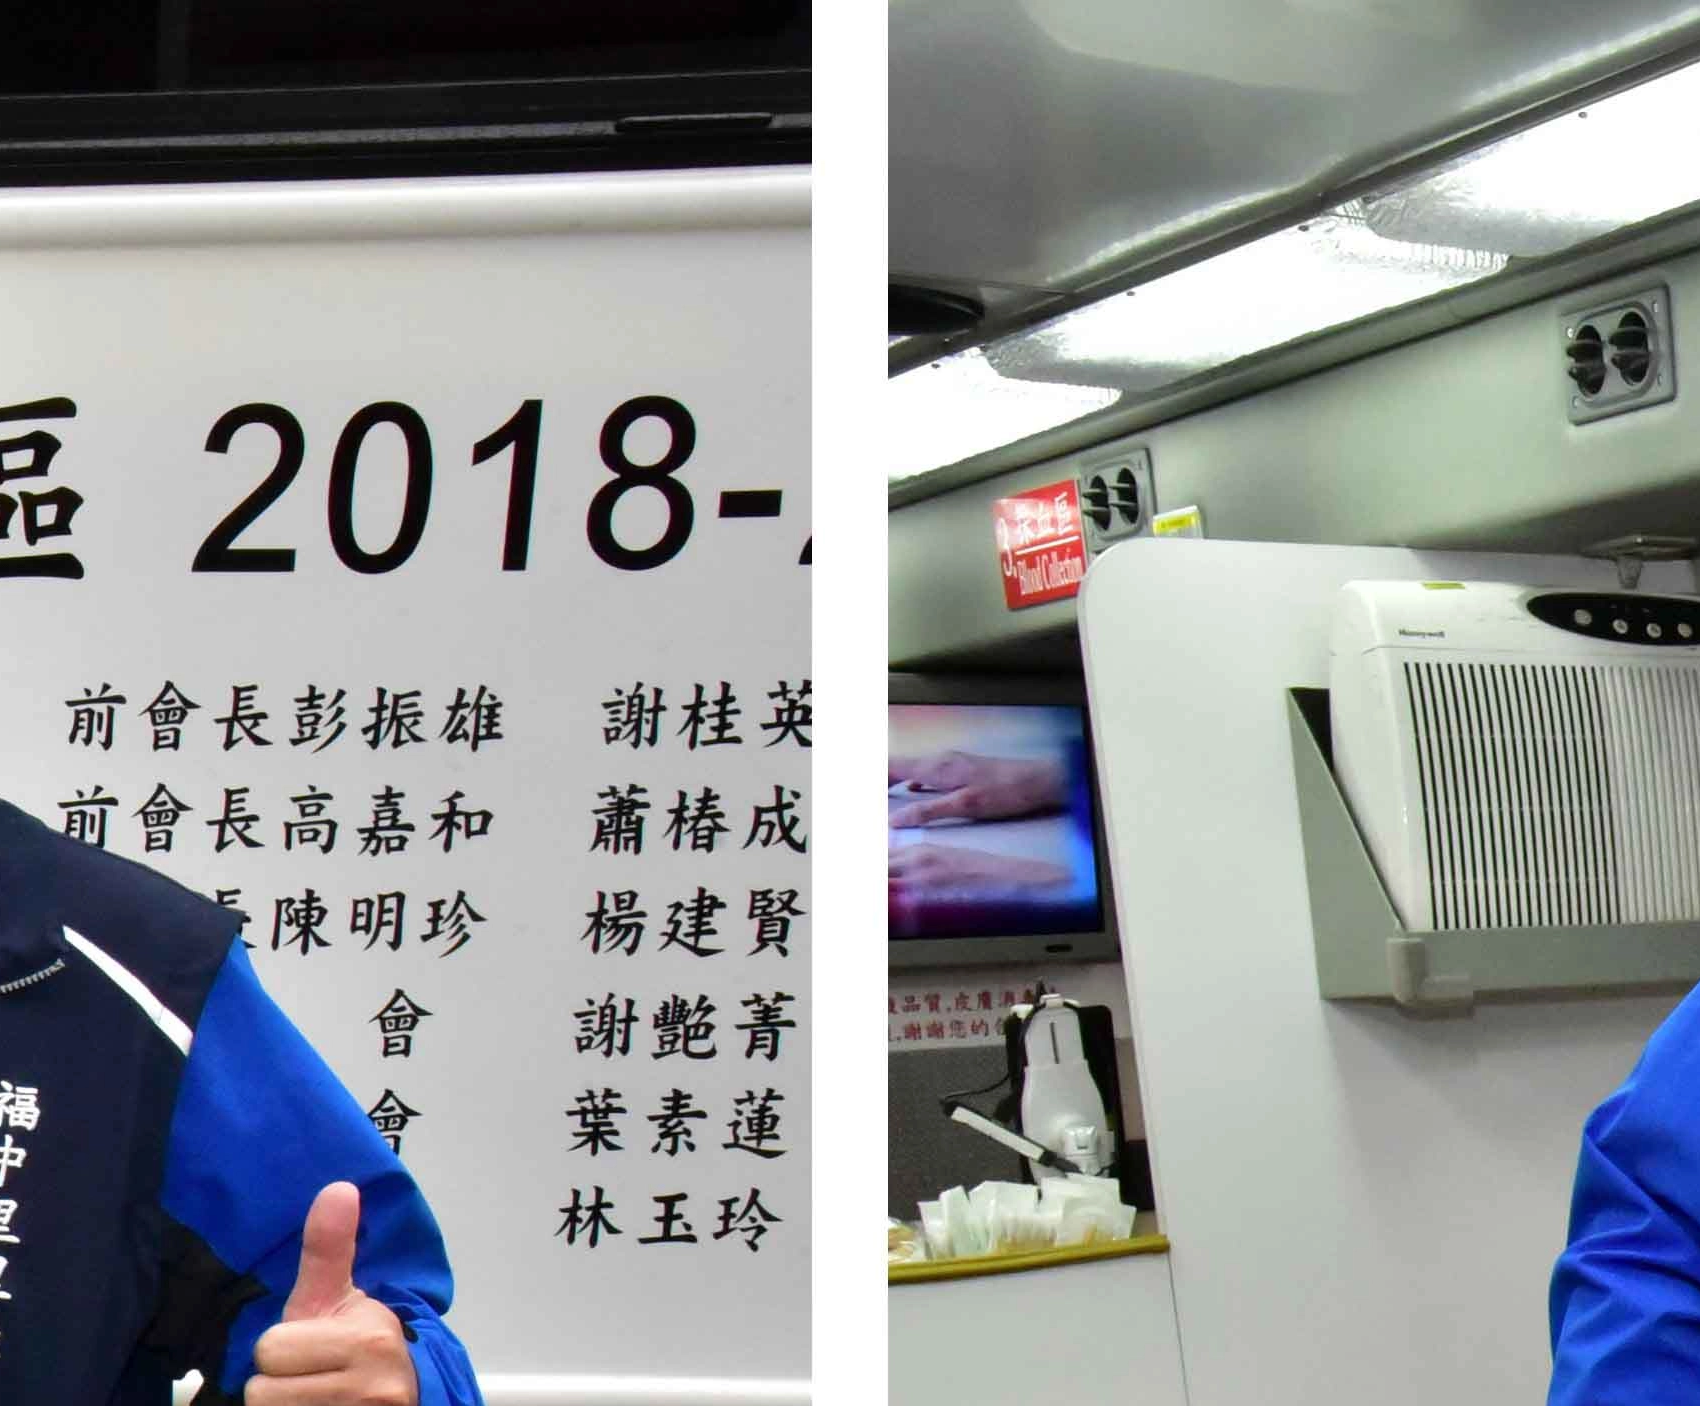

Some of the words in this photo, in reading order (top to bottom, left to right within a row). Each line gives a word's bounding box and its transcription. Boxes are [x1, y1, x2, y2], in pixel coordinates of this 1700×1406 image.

[191, 395, 812, 575] 2018-
[63, 680, 505, 755] 前會長彭振雄
[601, 680, 812, 754] 謝桂英
[58, 783, 494, 857] 前會長高嘉和
[590, 783, 810, 857] 蕭椿成
[579, 886, 807, 960] 楊建賢
[564, 1086, 788, 1159] 葉素蓮
[556, 1184, 784, 1252] 林玉玲
